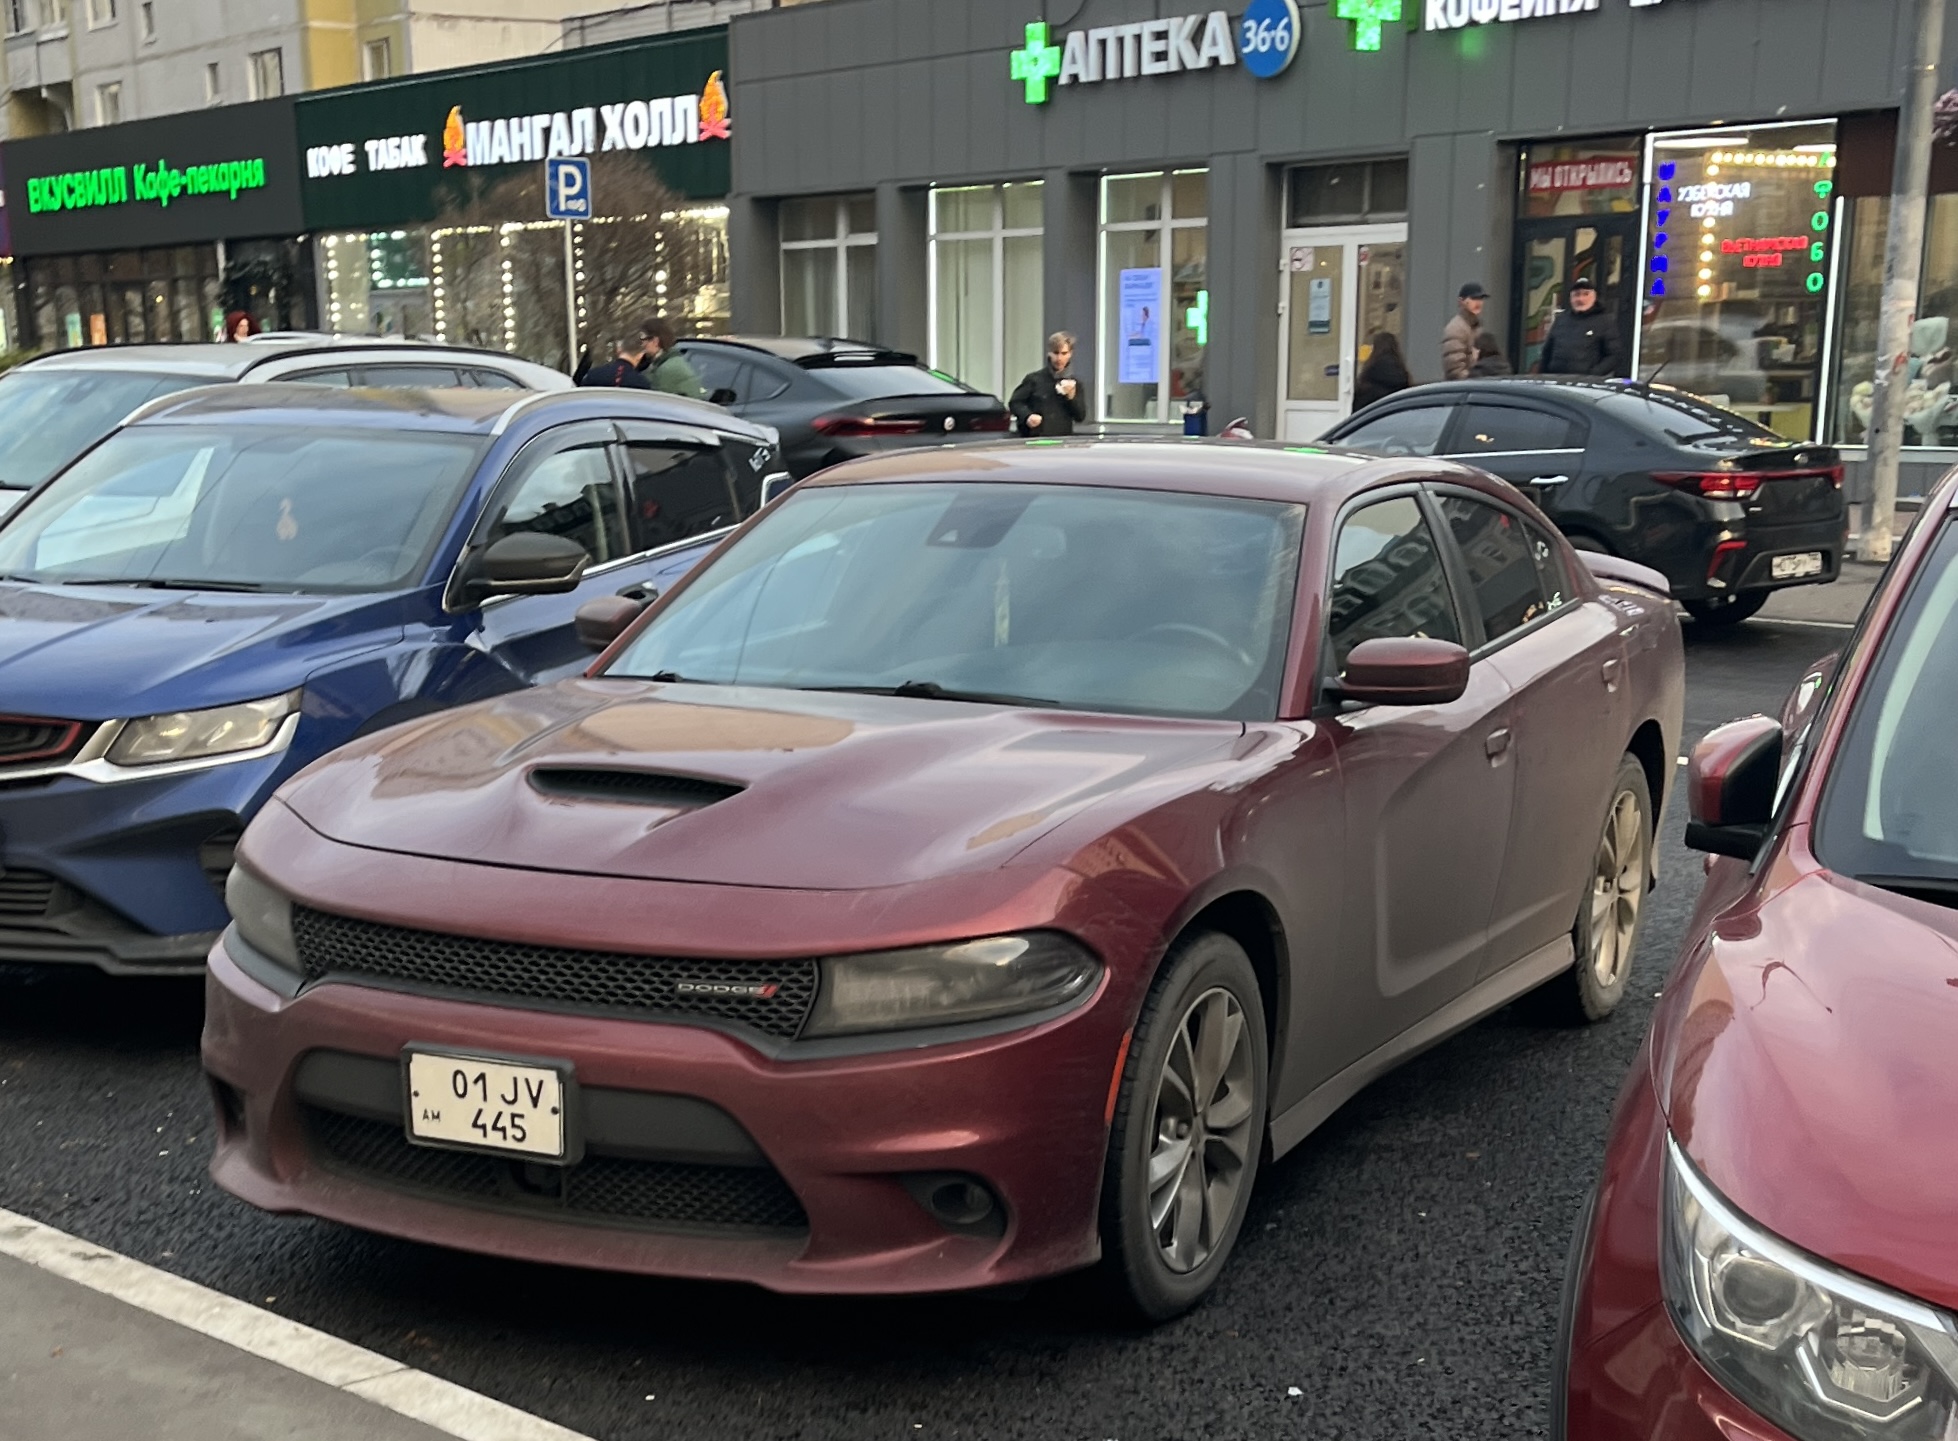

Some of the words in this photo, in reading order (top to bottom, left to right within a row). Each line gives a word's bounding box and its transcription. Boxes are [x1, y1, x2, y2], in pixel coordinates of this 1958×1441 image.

[1058, 11, 1236, 85] АПТЕКА
[465, 106, 598, 166] МАНГАЛ
[600, 94, 700, 151] ХОЛЛ
[307, 142, 357, 178] КОФЕ
[365, 134, 428, 172] ТАБАК
[1530, 166, 1552, 189] МЫ
[27, 166, 128, 213] ВКУСВИЛЛ
[133, 158, 265, 207] Кафе-пекарня
[558, 164, 582, 212] P
[677, 983, 766, 995] DODGE
[452, 1069, 488, 1102] 01
[501, 1076, 544, 1109] JV
[471, 1108, 527, 1143] 445
